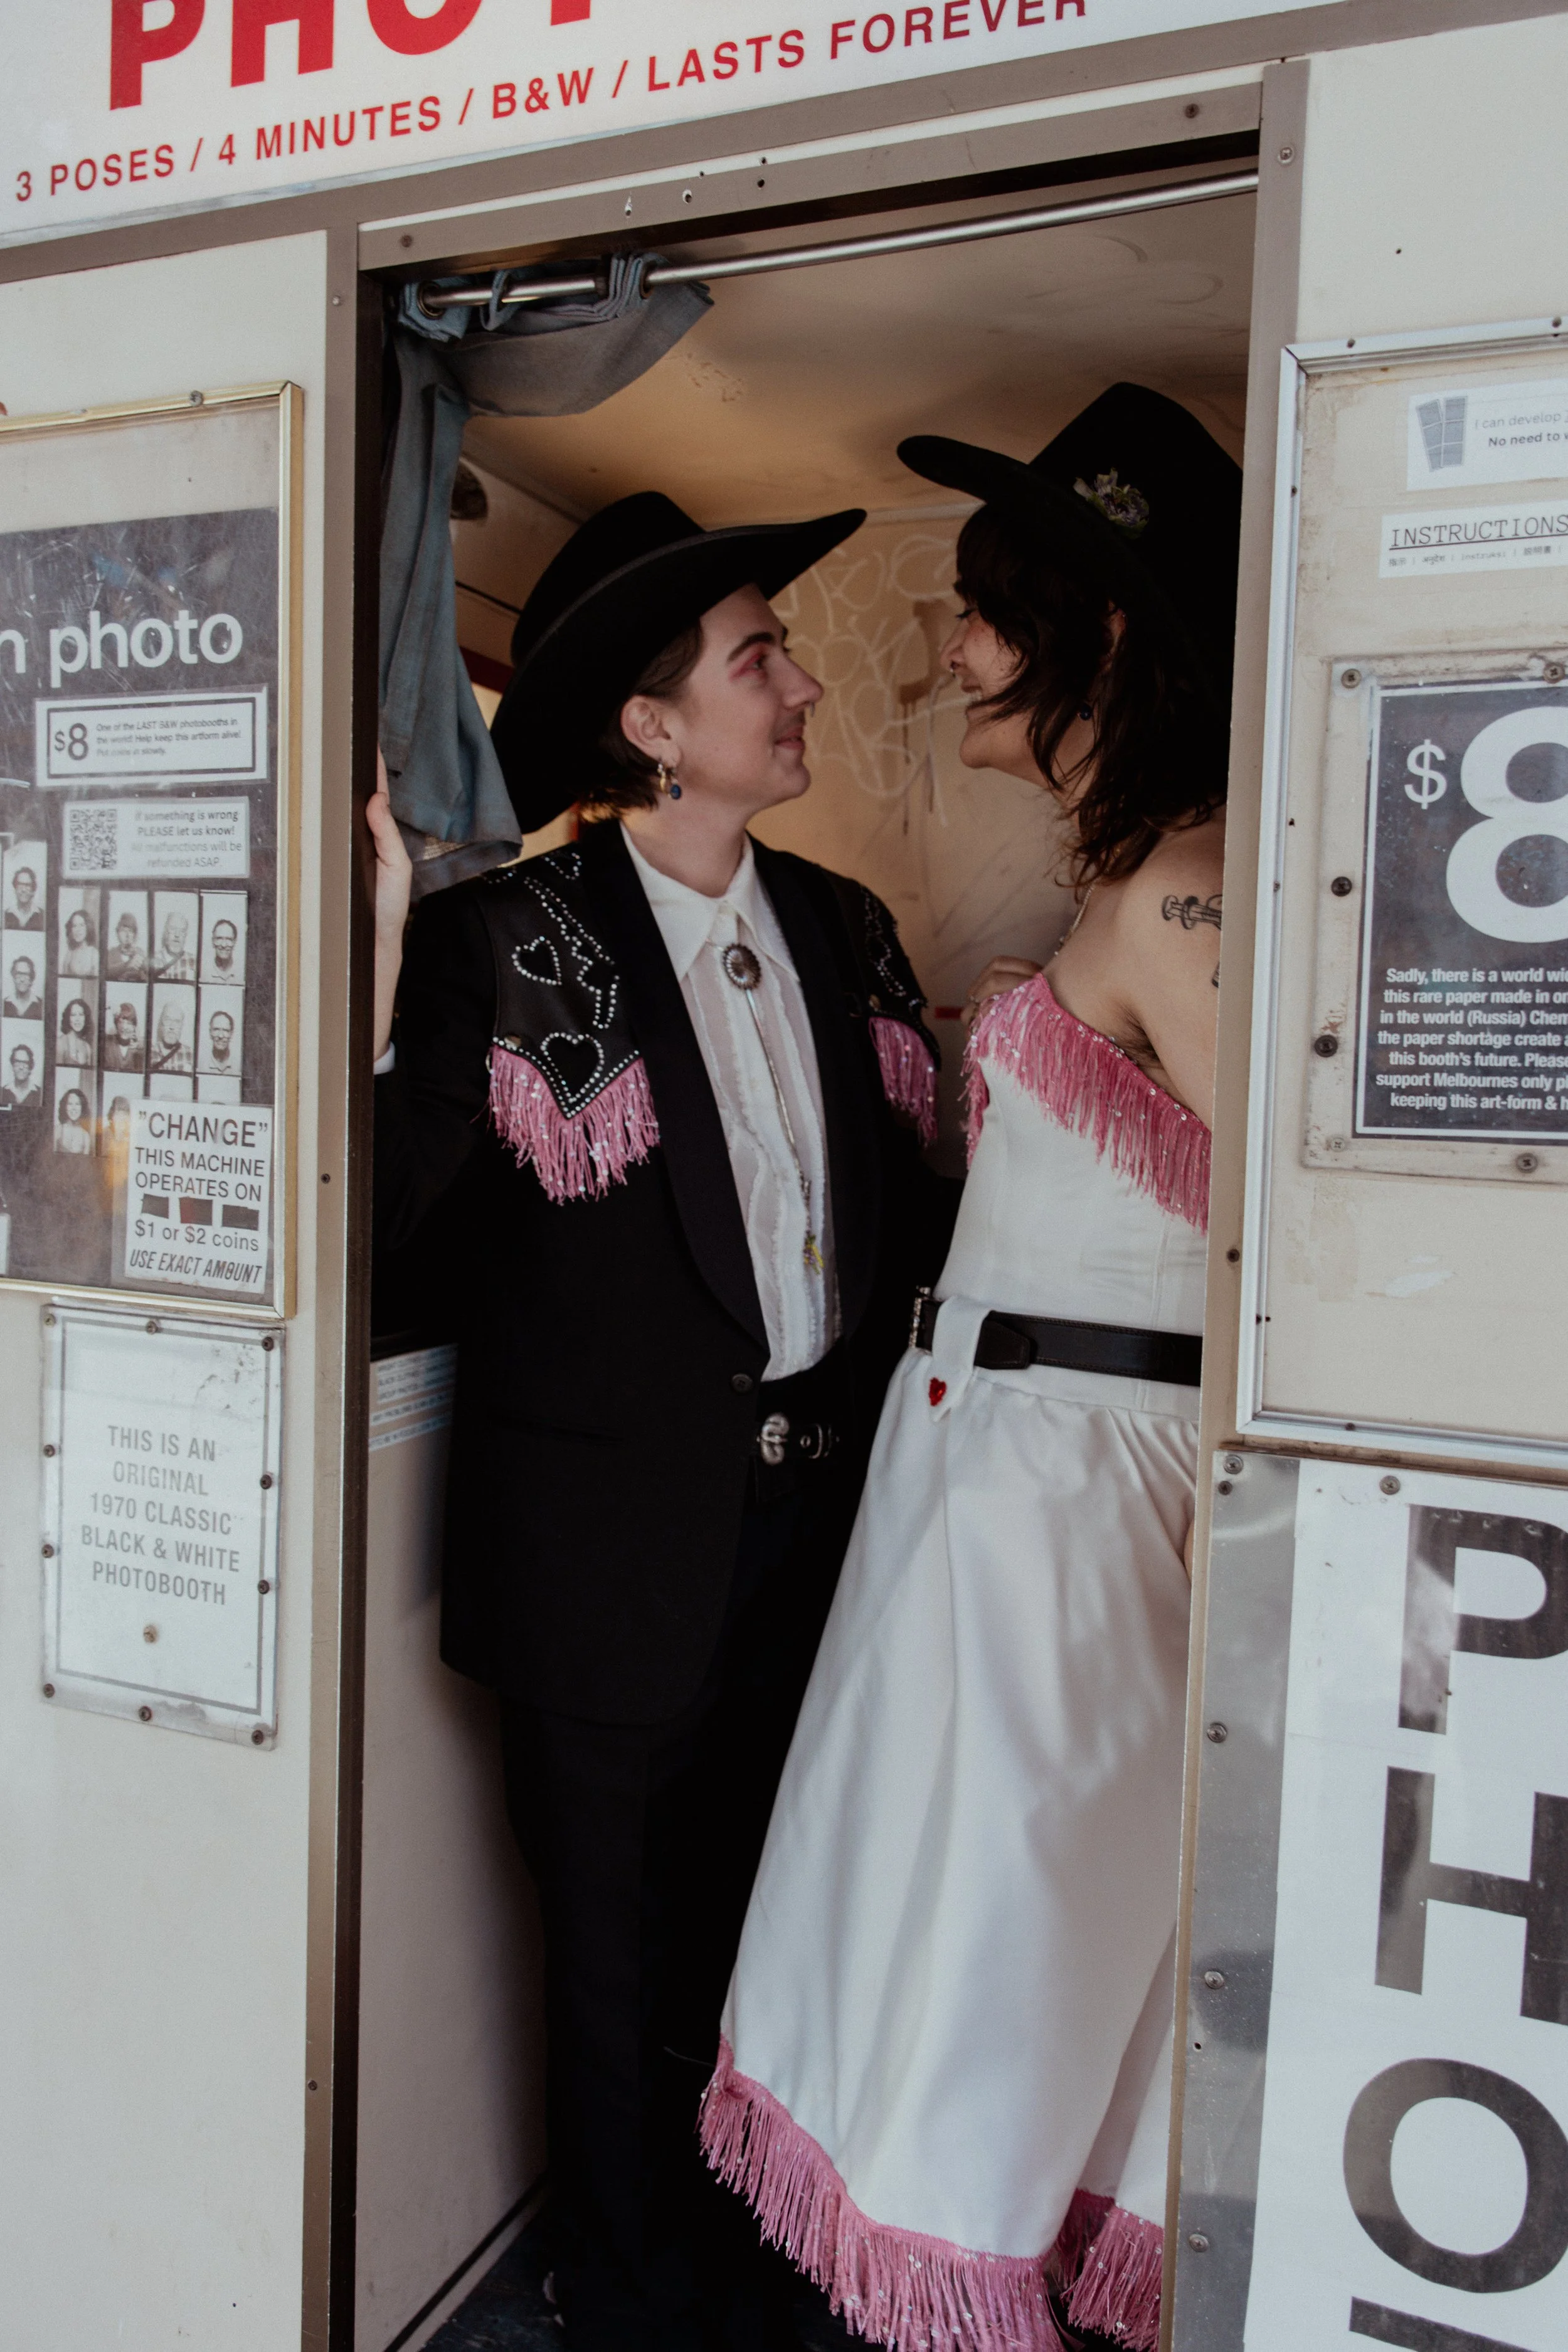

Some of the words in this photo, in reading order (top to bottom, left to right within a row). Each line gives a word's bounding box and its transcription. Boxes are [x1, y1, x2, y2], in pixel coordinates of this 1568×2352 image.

[16, 171, 31, 201] 3
[51, 145, 174, 196] POSES
[218, 134, 236, 165] 4
[256, 96, 440, 160] MINUTES
[492, 67, 594, 119] B&W
[648, 29, 805, 92] LASTS
[1483, 418, 1505, 428] can
[1508, 413, 1561, 426] develop
[1488, 437, 1506, 447] No
[1510, 432, 1542, 445] need
[1547, 432, 1560, 442] to
[1391, 514, 1568, 547] INSTRUCTIONS
[50, 610, 243, 688] photo
[97, 723, 111, 732] One
[124, 722, 134, 731] the
[137, 720, 157, 730] LAST
[180, 719, 228, 729] photobooths
[230, 718, 238, 726] in
[54, 723, 88, 760] $8
[154, 734, 172, 743] keep
[175, 733, 188, 741] this
[222, 730, 241, 739] alive!
[144, 811, 195, 823] something
[198, 810, 205, 820] is
[208, 811, 239, 822] wrong
[137, 826, 174, 837] PLEASE
[177, 825, 189, 836] let
[192, 827, 203, 836] us
[206, 825, 236, 836] know!
[210, 840, 227, 852] will
[230, 840, 242, 852] be
[1386, 968, 1429, 985] Sadly,
[1432, 968, 1468, 983] there
[1472, 968, 1485, 983] is
[1488, 971, 1498, 982] a
[1502, 968, 1543, 983] world
[1384, 989, 1411, 1004] this
[1413, 991, 1443, 1004] rare
[1445, 991, 1487, 1006] paper
[1490, 989, 1532, 1004] made
[1535, 989, 1550, 1004] in
[1380, 1010, 1393, 1024] in
[1397, 1010, 1419, 1024] the
[1423, 1010, 1463, 1024] world
[1467, 1010, 1527, 1027] (Russia)
[1378, 1030, 1400, 1045] the
[1403, 1033, 1445, 1047] paper
[1447, 1030, 1512, 1049] shortage
[1514, 1032, 1562, 1046] create
[1389, 1052, 1415, 1066] this
[1419, 1051, 1471, 1066] booth's
[1474, 1052, 1522, 1067] future.
[1376, 1073, 1431, 1089] support
[1433, 1073, 1518, 1088] Melbournes
[1521, 1074, 1552, 1091] only
[1391, 1093, 1447, 1111] keeping
[1450, 1093, 1477, 1109] this
[1480, 1094, 1542, 1110] art-form
[1544, 1095, 1557, 1111] &
[135, 1147, 174, 1167] THIS
[181, 1152, 265, 1177] MACHINE
[135, 1172, 229, 1198] OPERATES
[235, 1183, 262, 1202] ON
[135, 1219, 154, 1238] $1
[162, 1227, 180, 1241] or
[184, 1226, 206, 1244] $2
[212, 1232, 259, 1251] coins
[130, 1248, 157, 1269] USE
[158, 1253, 203, 1276] EXACT
[203, 1259, 262, 1283] AMOUNT
[108, 1425, 152, 1452] THIS
[161, 1433, 179, 1456] IS
[188, 1437, 216, 1461] AN
[113, 1460, 209, 1496] ORIGINAL
[91, 1491, 137, 1519] 1970
[145, 1500, 232, 1535] CLASSIC
[81, 1524, 146, 1556] BLACK
[153, 1537, 167, 1559] &
[175, 1540, 240, 1572] WHITE
[92, 1560, 226, 1606] PHOTOBOOTH
